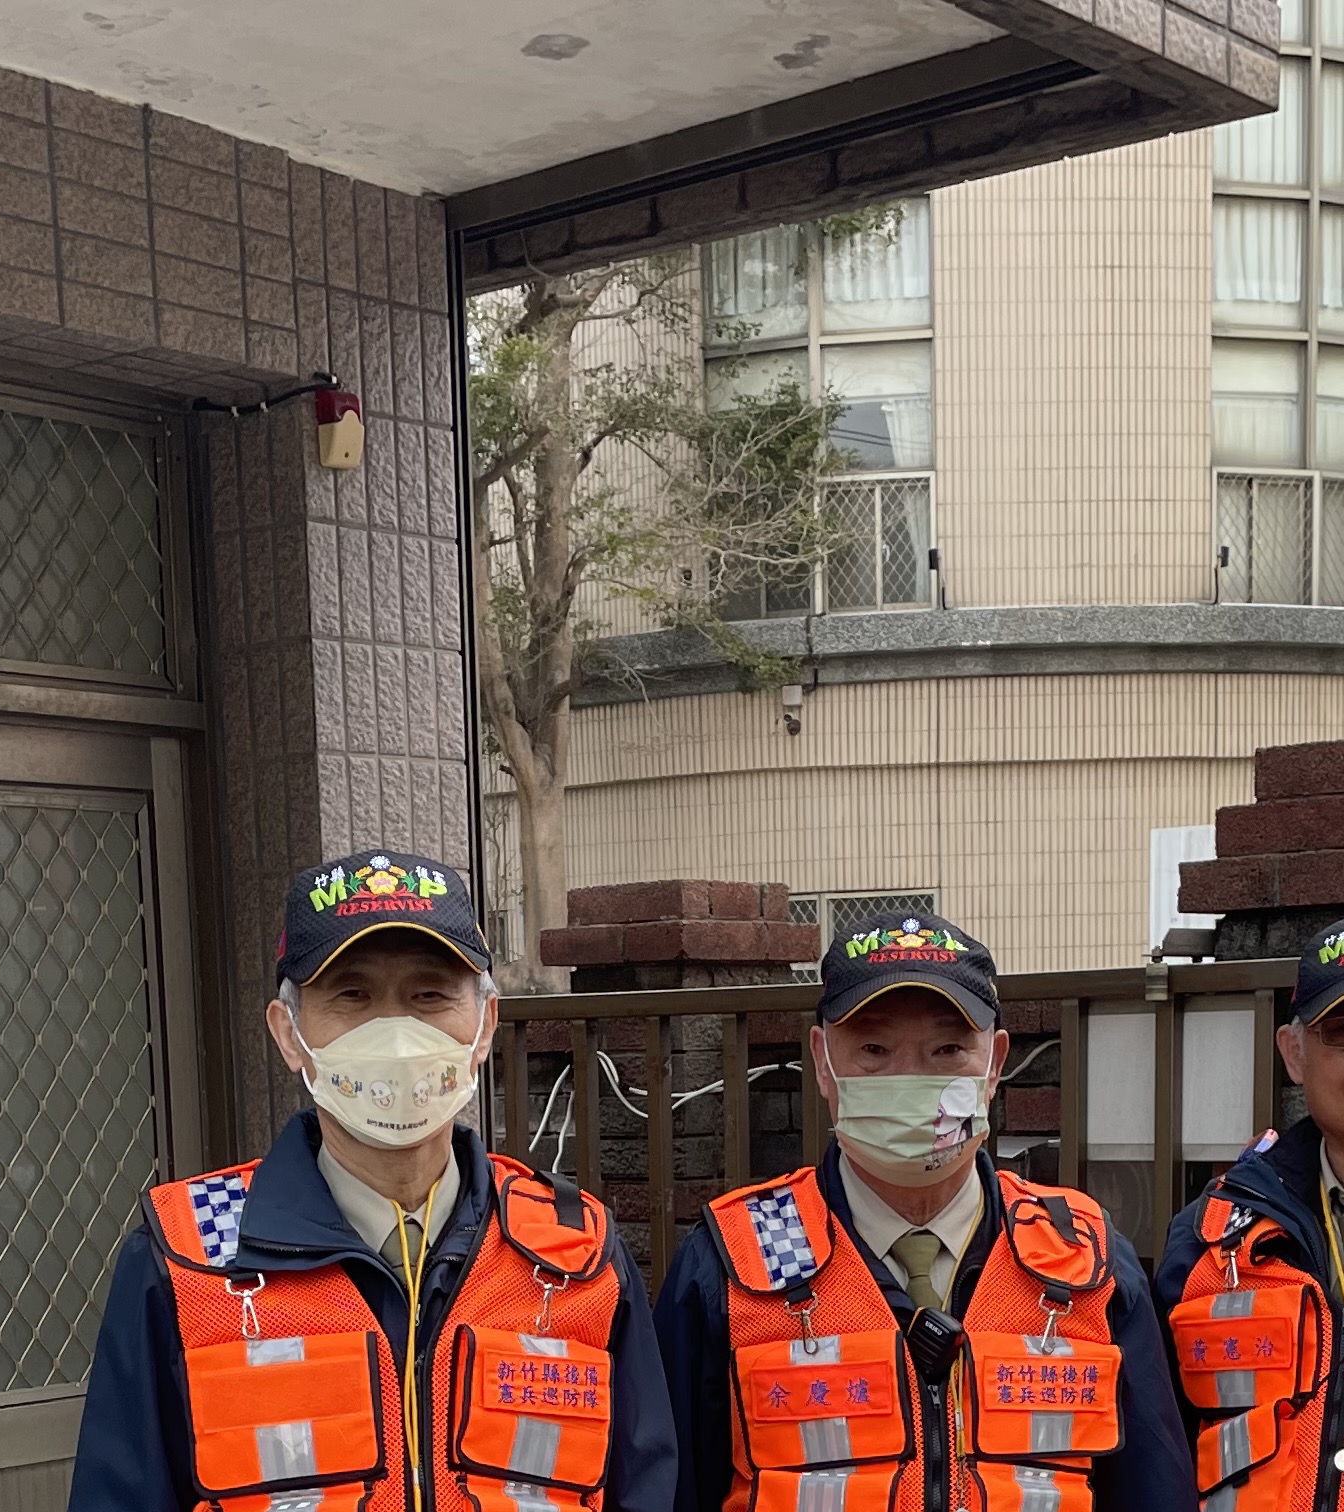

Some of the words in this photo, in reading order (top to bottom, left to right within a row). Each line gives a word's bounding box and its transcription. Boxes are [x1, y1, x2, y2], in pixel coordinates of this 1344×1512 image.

[336, 898, 434, 917] RESERVIST
[867, 950, 958, 965] RESERVIST
[497, 1360, 599, 1387] 新竹縣後備
[996, 1363, 1100, 1385] 新竹縣後備
